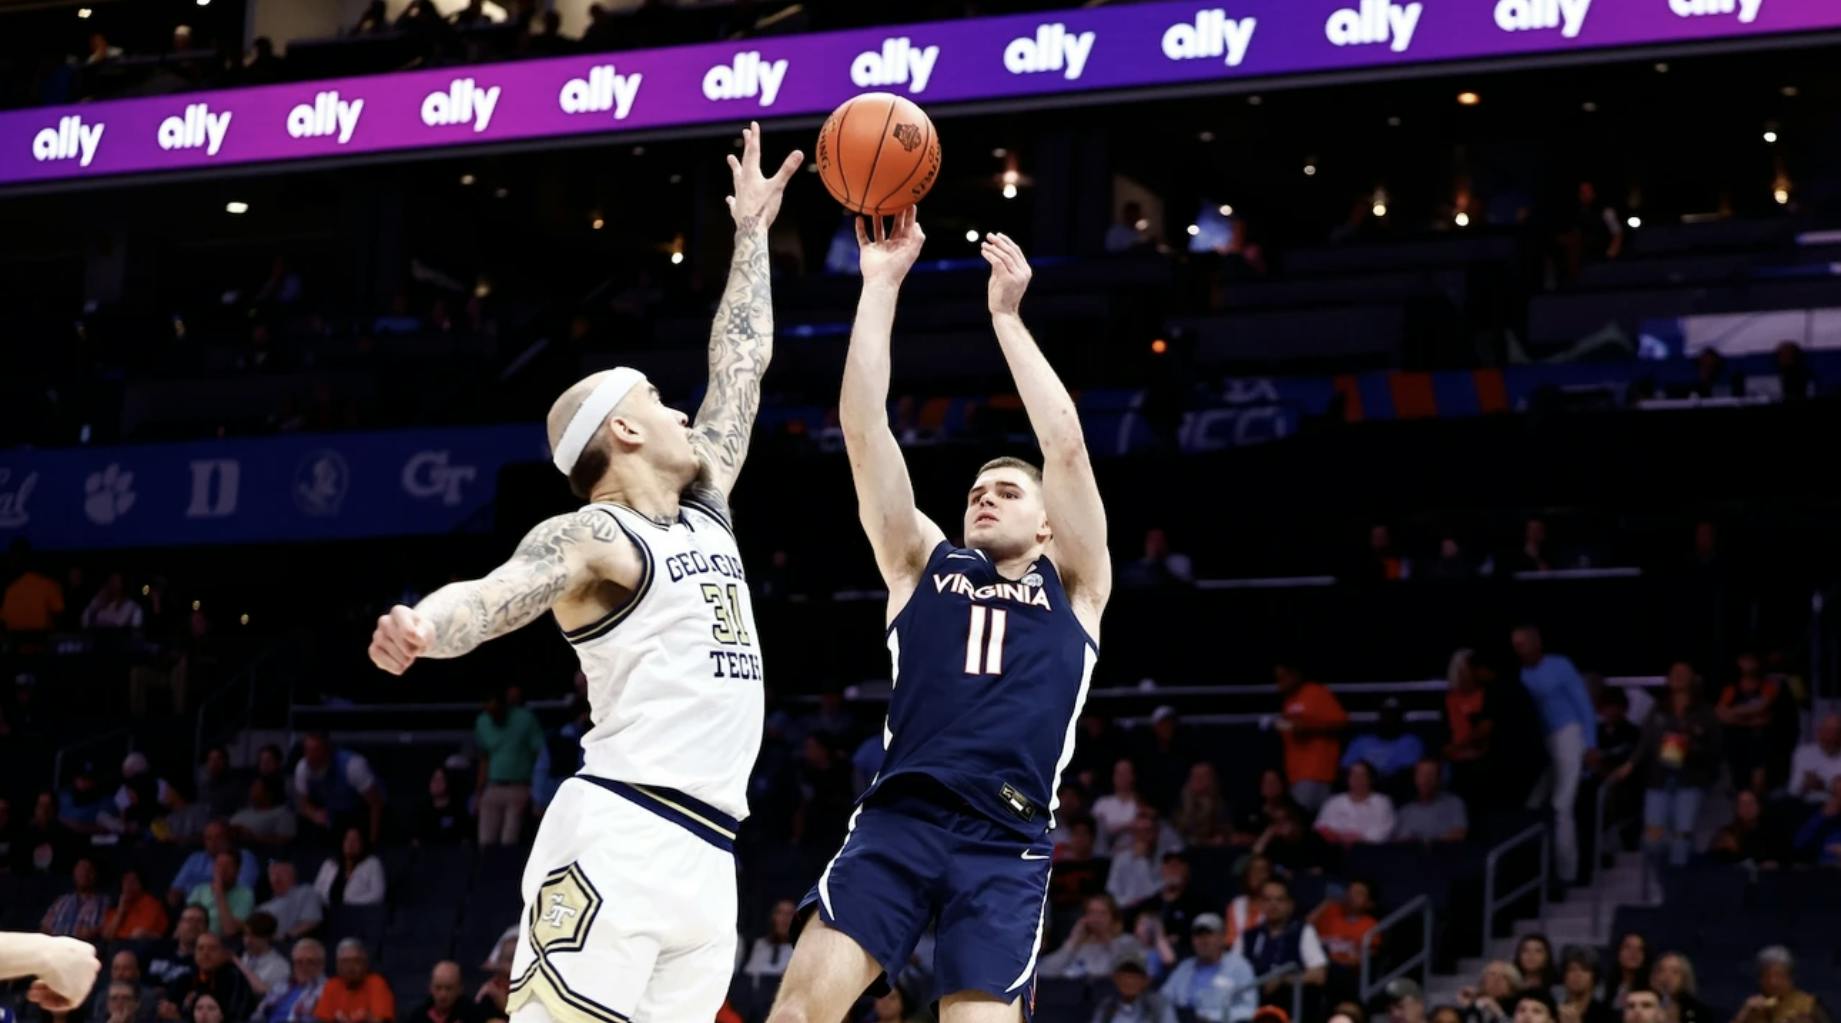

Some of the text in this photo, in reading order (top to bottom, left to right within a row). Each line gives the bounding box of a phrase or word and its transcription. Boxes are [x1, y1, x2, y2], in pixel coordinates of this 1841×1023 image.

[32, 115, 104, 167] ally
[158, 103, 232, 156] ally
[287, 91, 364, 144] ally
[421, 78, 501, 132] ally
[559, 65, 642, 119] ally
[702, 51, 788, 107] ally
[850, 37, 939, 93] ally
[1003, 23, 1095, 80] ally
[1162, 8, 1256, 66] ally
[1325, 0, 1422, 52] ally
[0, 467, 40, 530] al
[185, 458, 242, 519] D
[401, 450, 478, 506] GT
[665, 550, 744, 583] GEOGIA
[932, 573, 1052, 612] VIRGINIA
[700, 583, 751, 646] 31
[964, 604, 1007, 676] 11
[709, 650, 762, 681] TECH
